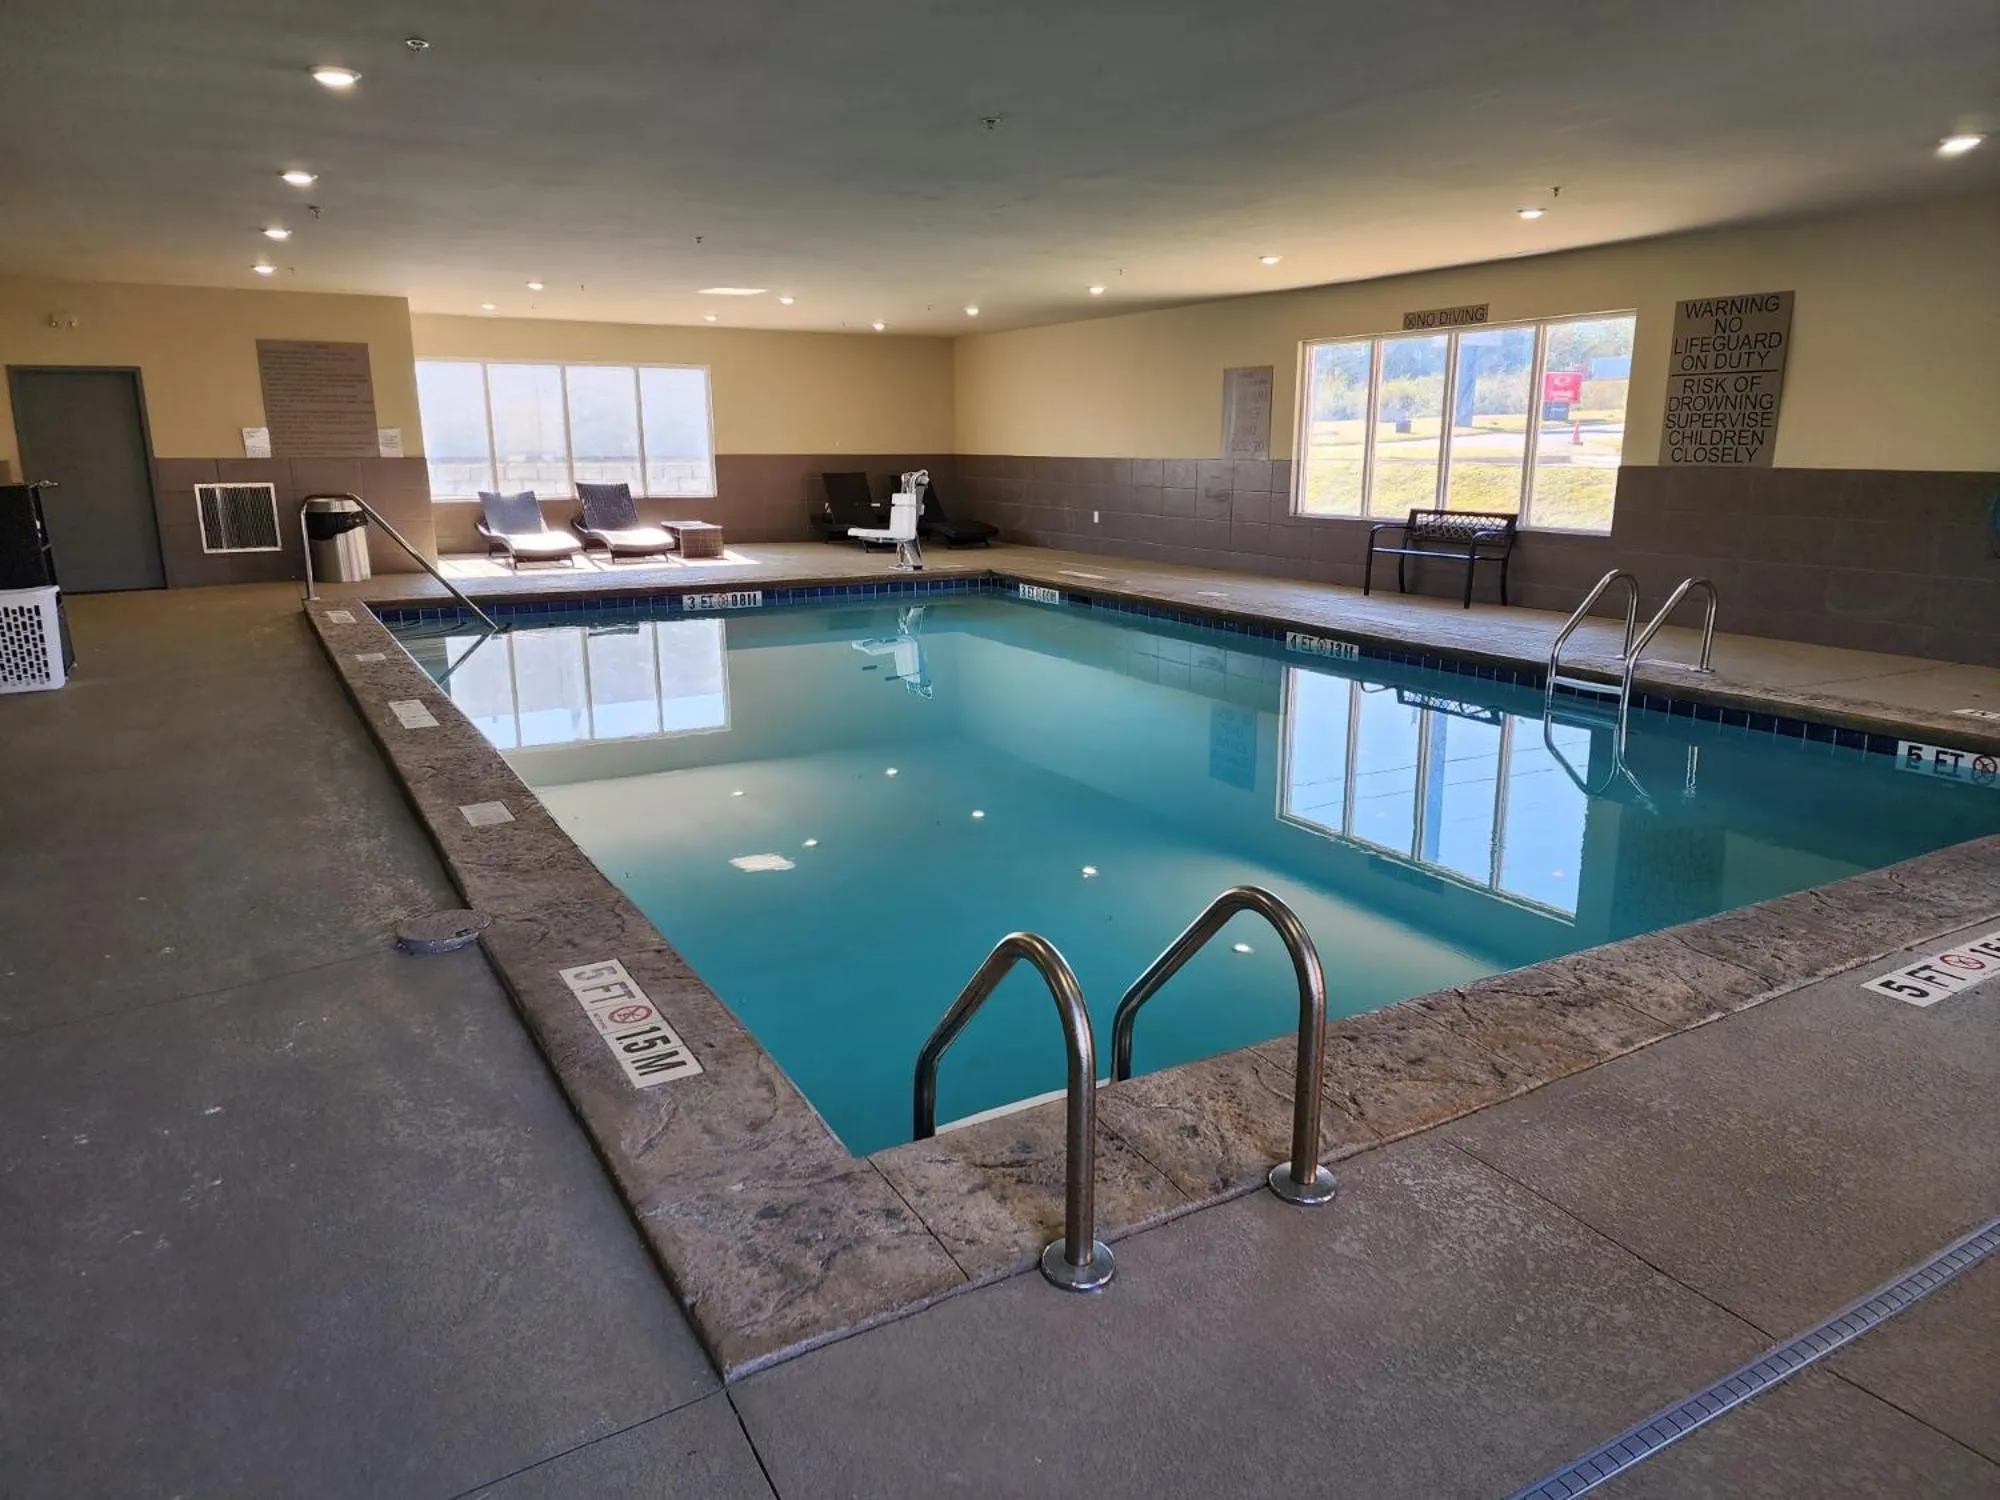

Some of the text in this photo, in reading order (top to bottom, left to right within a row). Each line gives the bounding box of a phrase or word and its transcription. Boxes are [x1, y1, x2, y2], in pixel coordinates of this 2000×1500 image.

[1684, 295, 1780, 319] WARNING
[1417, 307, 1485, 326] NO DIVING
[1714, 316, 1743, 334] NO
[1674, 331, 1782, 354] LIFEGUARD
[1681, 351, 1770, 371] ON DUTY
[1682, 376, 1762, 394] RISK OF
[1668, 393, 1773, 412] DROWNING
[1666, 411, 1773, 429] SUPERVISE
[1668, 429, 1765, 446] CHILDREN
[1671, 447, 1758, 463] CLOSELY
[687, 596, 695, 609] 3
[573, 966, 617, 981] 5
[1878, 980, 1929, 998] 5
[1905, 964, 1967, 987] FT
[581, 981, 636, 1004] FT
